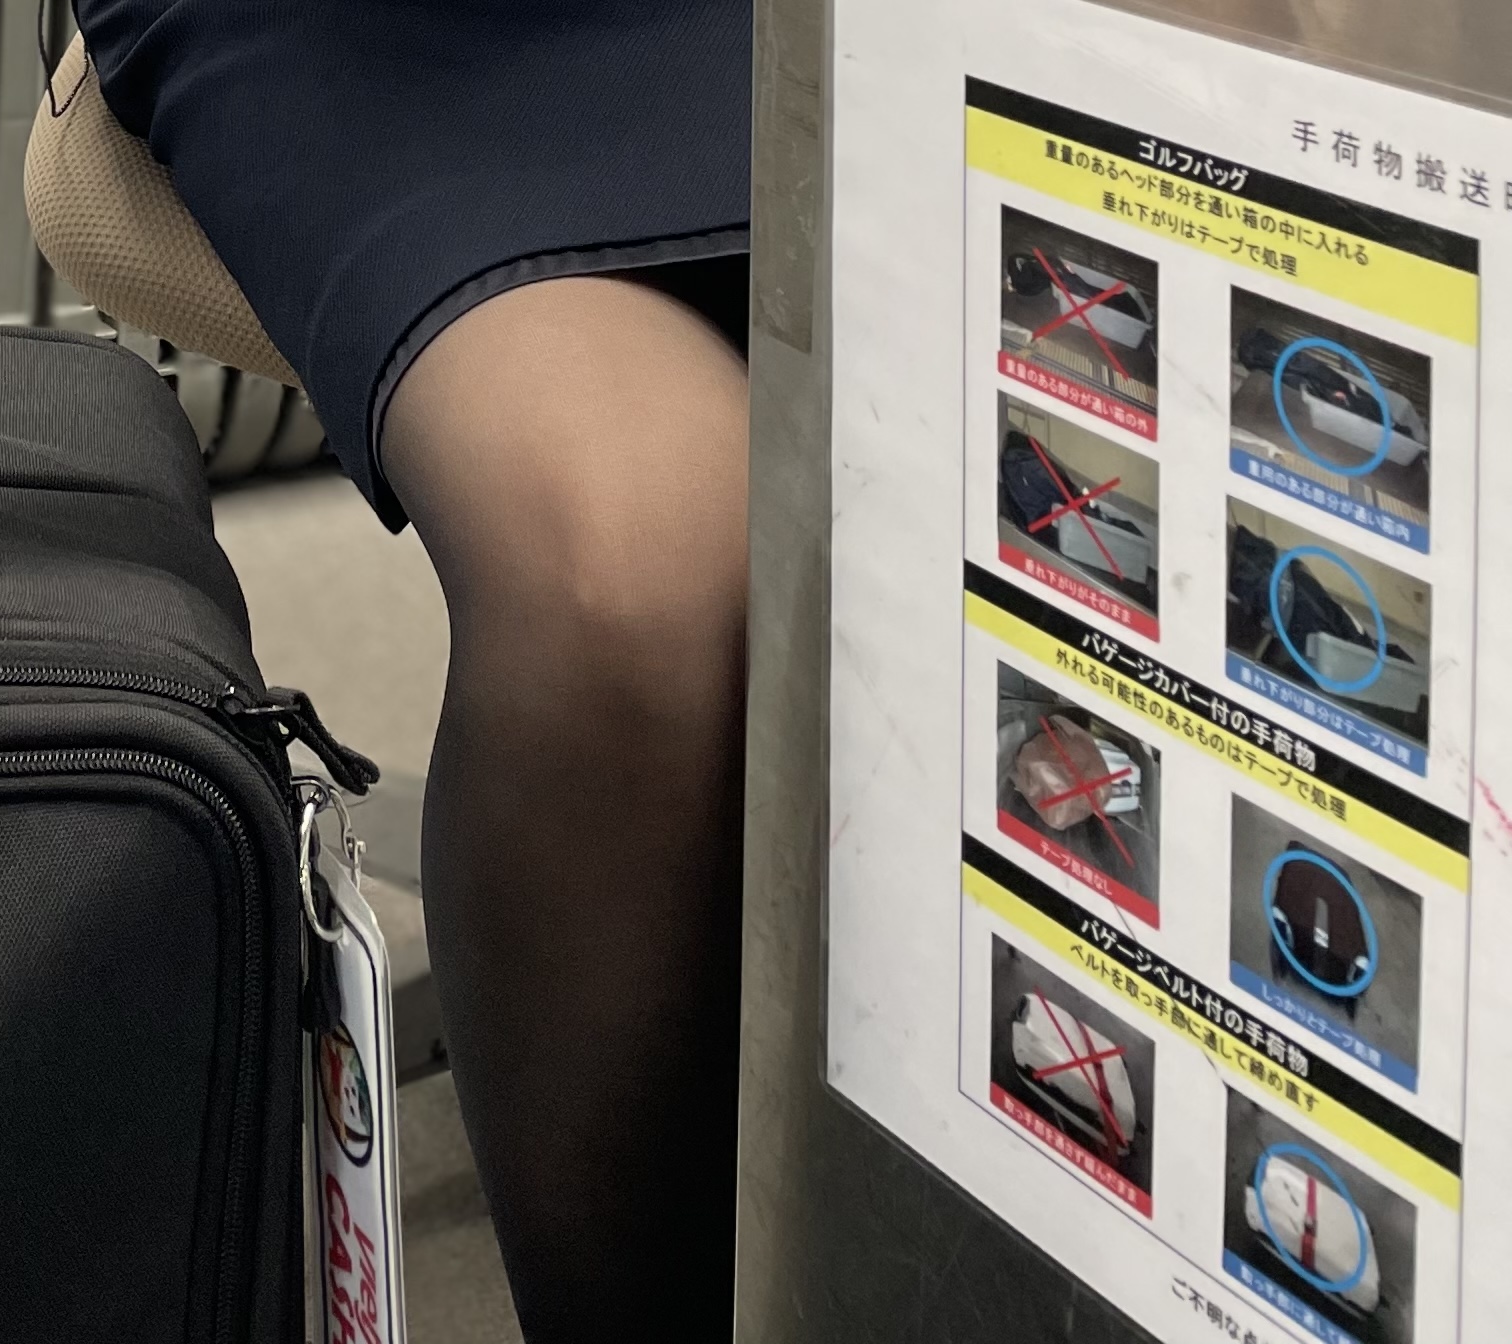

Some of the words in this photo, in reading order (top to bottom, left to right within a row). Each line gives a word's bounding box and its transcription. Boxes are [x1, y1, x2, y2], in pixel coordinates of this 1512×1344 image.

[1044, 138, 1370, 267] 重量のあるヘッド部分を通い箱の中に入れる
[1138, 139, 1249, 191] ゴルフバッグ
[1102, 190, 1298, 277] 垂れ下がりはテープで処理
[1055, 647, 1348, 822] 外れる可能性のあるものはテープで処理
[1081, 632, 1317, 773] バゲージカバー付の手荷物
[1081, 918, 1310, 1078] バゲージベルト付の手荷物
